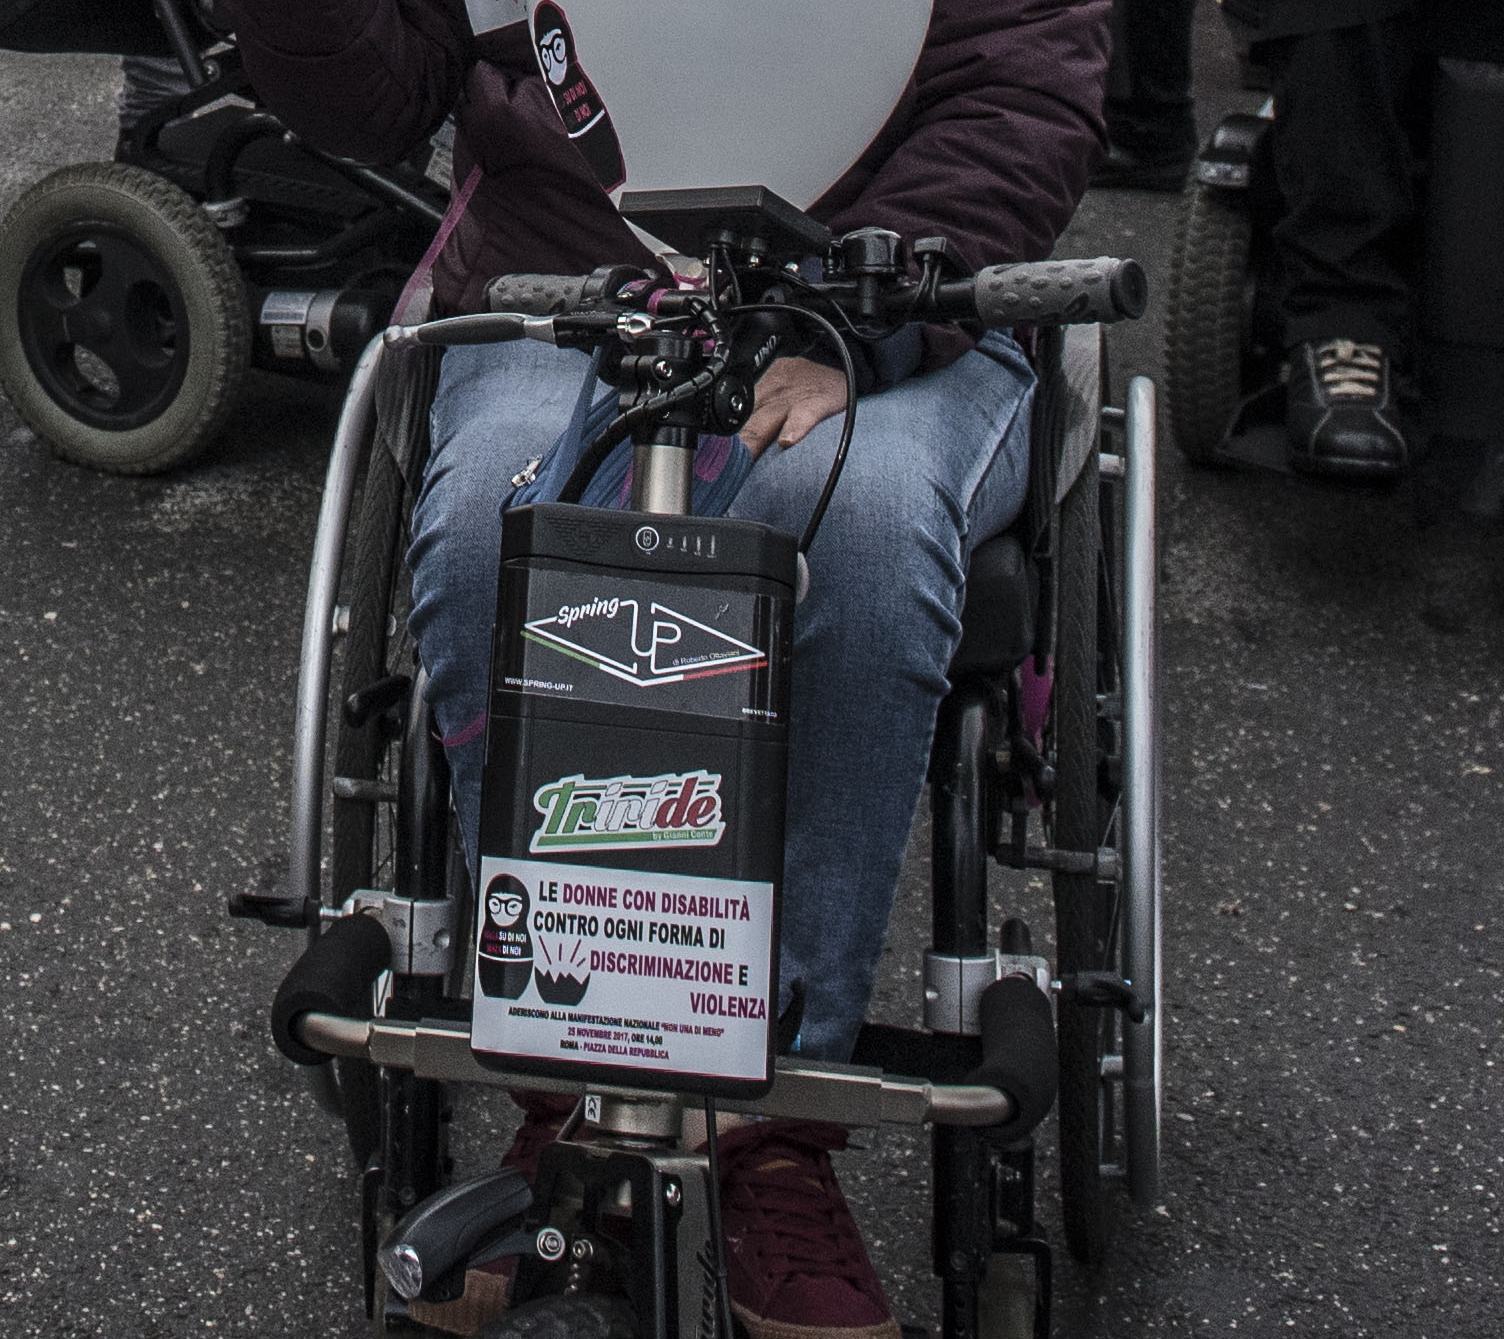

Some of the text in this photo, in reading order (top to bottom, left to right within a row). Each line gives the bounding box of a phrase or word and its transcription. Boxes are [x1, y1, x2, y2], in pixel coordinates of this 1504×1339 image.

[557, 597, 620, 628] Spring
[504, 676, 574, 692] WWW.SPRING-UP.IT
[538, 776, 718, 835] Triride
[652, 829, 714, 841] by Gianni Conte
[538, 880, 751, 922] LE DONNE CON DISABILITÀ
[499, 931, 507, 942] SU
[508, 932, 515, 943] DI
[515, 933, 527, 943] NOI
[533, 910, 725, 950] CONTRO OGNI FORMA DI
[502, 944, 509, 955] DI
[510, 945, 522, 956] NOI
[589, 950, 749, 986] DISCRIMINAZIONE E
[689, 991, 767, 1020] VIOLENZA
[508, 1006, 549, 1019] ADERISCONO
[550, 1011, 567, 1022] ALLA
[568, 1013, 623, 1027] MANIFESTAZIONE
[624, 1018, 660, 1030] NAZIONALE
[679, 1023, 693, 1035] UNA
[694, 1026, 702, 1036] DI
[567, 1026, 663, 1045] 25 NOVEMBRE 2017, ORE 14,00
[560, 1039, 579, 1051] ROMA
[583, 1041, 607, 1054] PIAZZA
[607, 1044, 628, 1056] DELLA
[629, 1046, 670, 1060] REPUBBLICA
